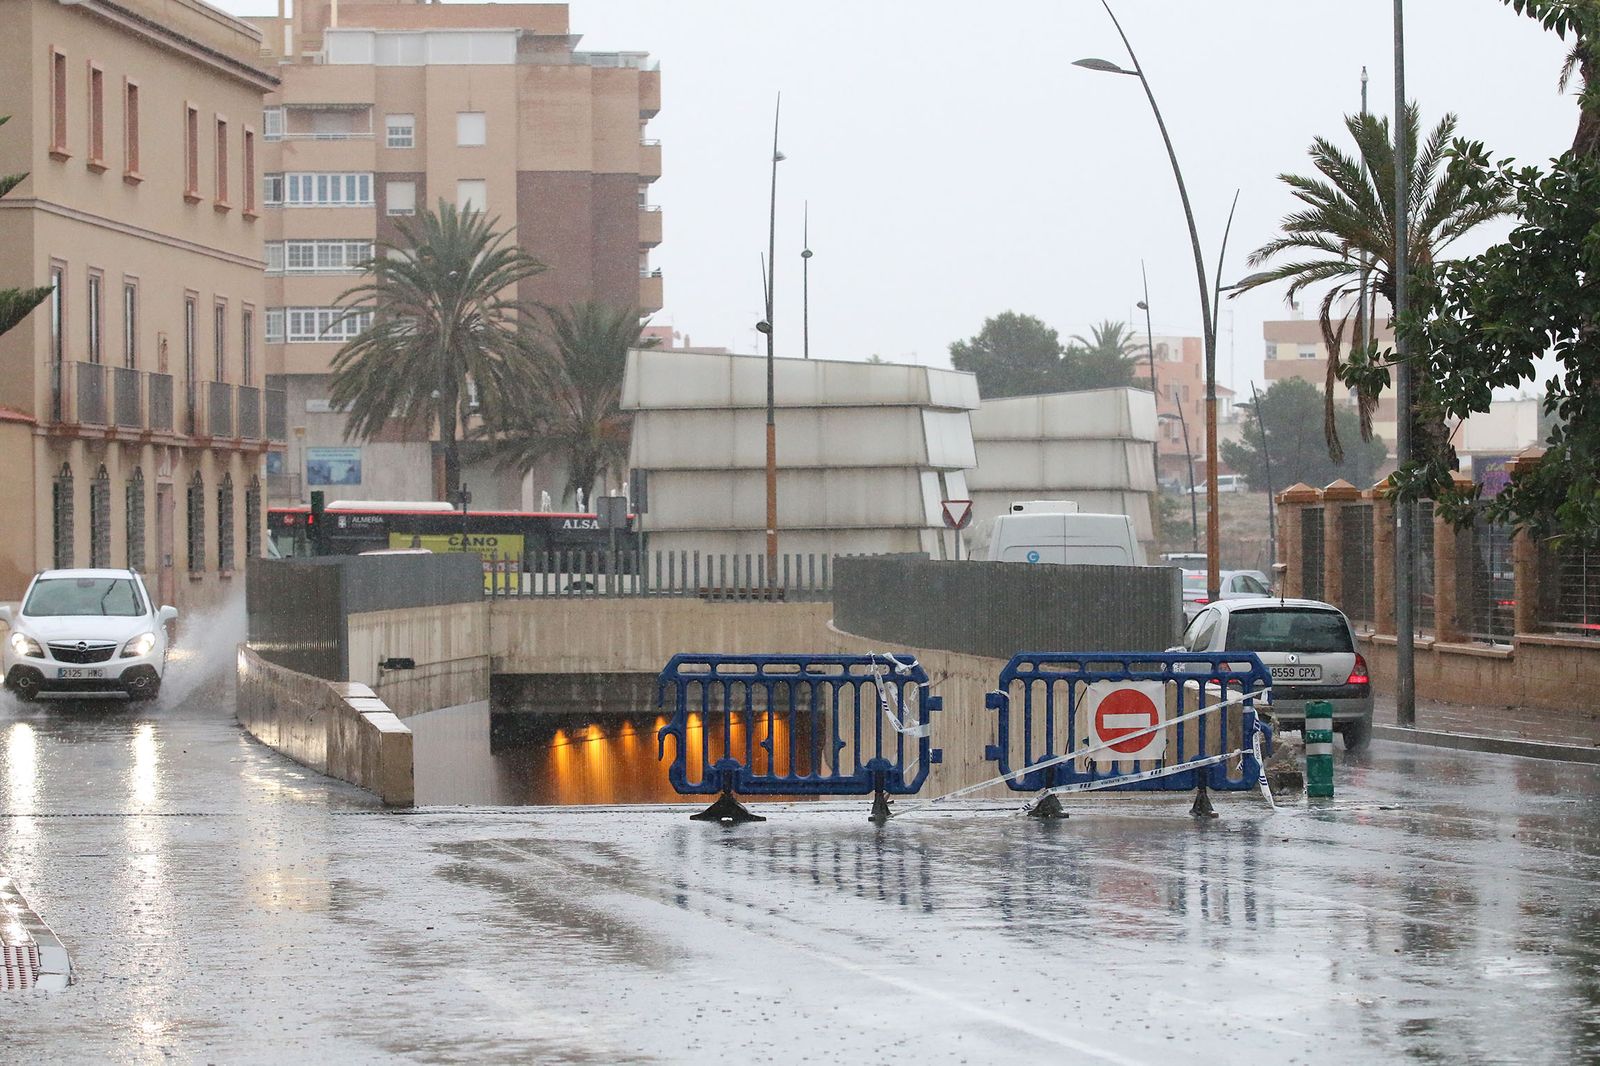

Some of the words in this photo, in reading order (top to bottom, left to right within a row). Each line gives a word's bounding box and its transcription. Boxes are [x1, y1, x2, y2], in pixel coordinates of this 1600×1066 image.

[563, 519, 600, 529] ALSA
[448, 537, 498, 546] CANO
[63, 669, 82, 678] 2125
[1271, 667, 1295, 678] 8559
[1298, 667, 1316, 678] CPX
